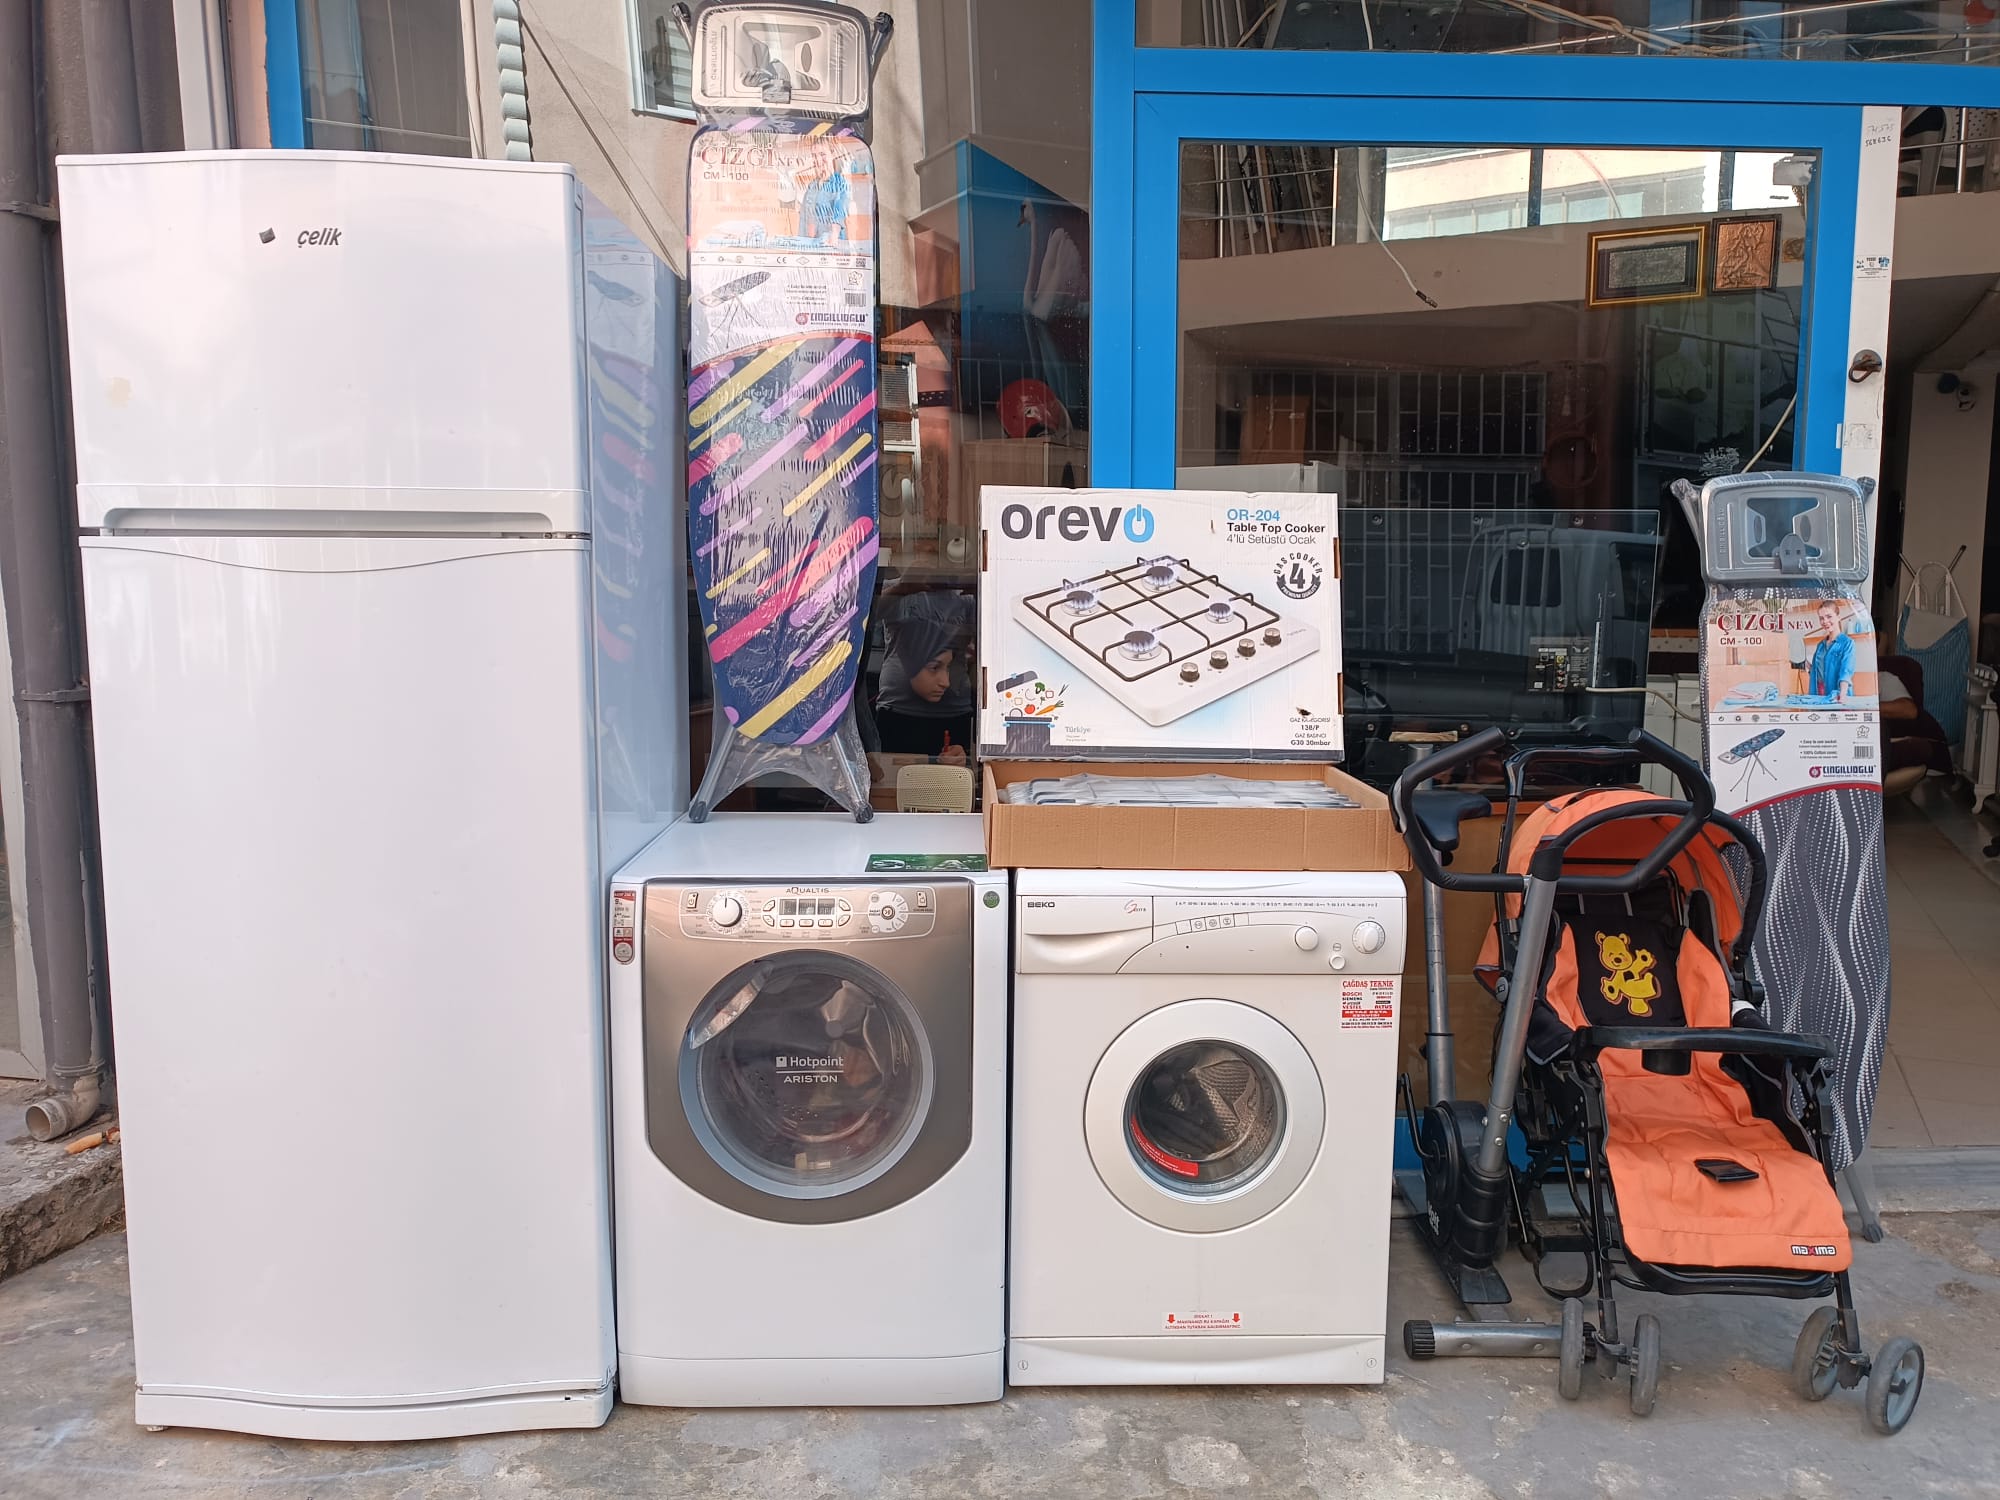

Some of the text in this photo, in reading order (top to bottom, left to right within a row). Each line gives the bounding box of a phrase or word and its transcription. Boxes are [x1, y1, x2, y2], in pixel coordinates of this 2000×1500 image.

[702, 142, 774, 169] ÇİZGİ
[704, 172, 720, 180] CM
[729, 172, 749, 181] 100
[297, 228, 342, 248] çelik
[1227, 509, 1280, 521] OR-204
[1001, 503, 1155, 543] orevo
[1227, 522, 1325, 534] Table Top Cooker
[1226, 534, 1316, 544] 4'lü Setüstü Ocak
[1273, 552, 1323, 574] GAS COOKER
[1289, 563, 1305, 589] 4
[1717, 609, 1814, 635] ÇİZGİ NEW
[1720, 637, 1736, 645] CM
[1744, 637, 1762, 645] 100
[1065, 726, 1091, 734] Türkiye
[1342, 979, 1393, 989] ÇAĞDAŞ TEKNİK
[790, 1056, 844, 1069] Hotpoint
[783, 1075, 838, 1083] ARISTON
[1792, 1246, 1836, 1255] maxima
